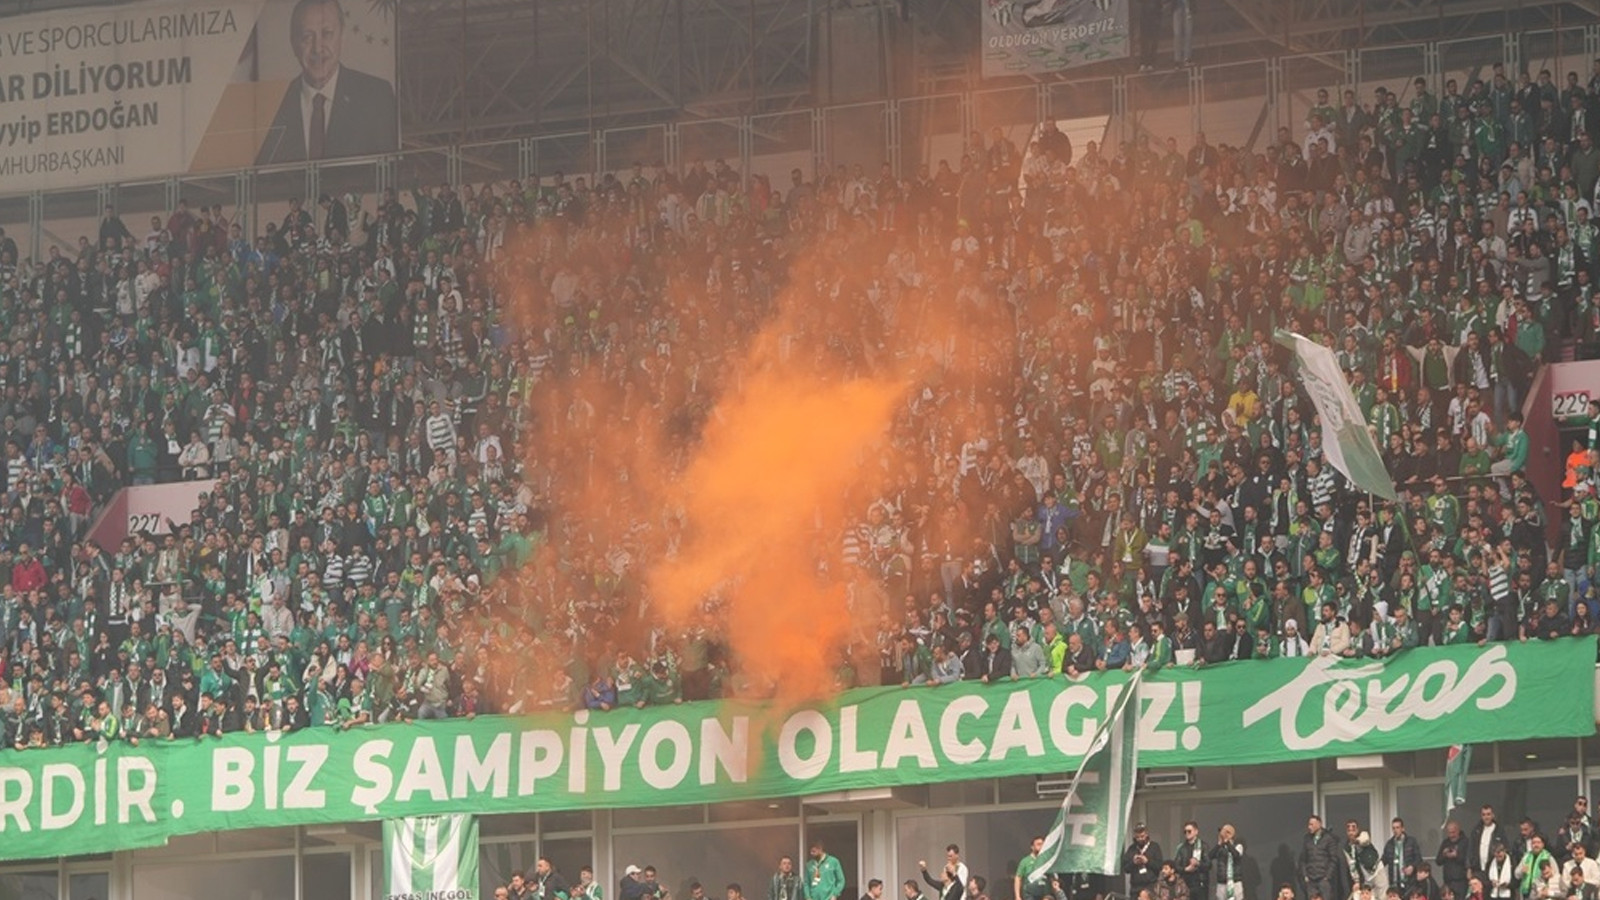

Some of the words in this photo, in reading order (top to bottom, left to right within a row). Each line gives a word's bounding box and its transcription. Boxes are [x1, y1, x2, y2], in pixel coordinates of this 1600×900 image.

[8, 31, 34, 56] VE
[38, 9, 237, 53] SPORCULARIMIZA
[33, 56, 191, 99] DİLİYORUM
[47, 101, 158, 136] ERDOĞAN
[1554, 392, 1590, 415] 229
[130, 514, 160, 534] 227
[211, 730, 329, 811] BİZ
[350, 709, 749, 814] ŞAMPİYON
